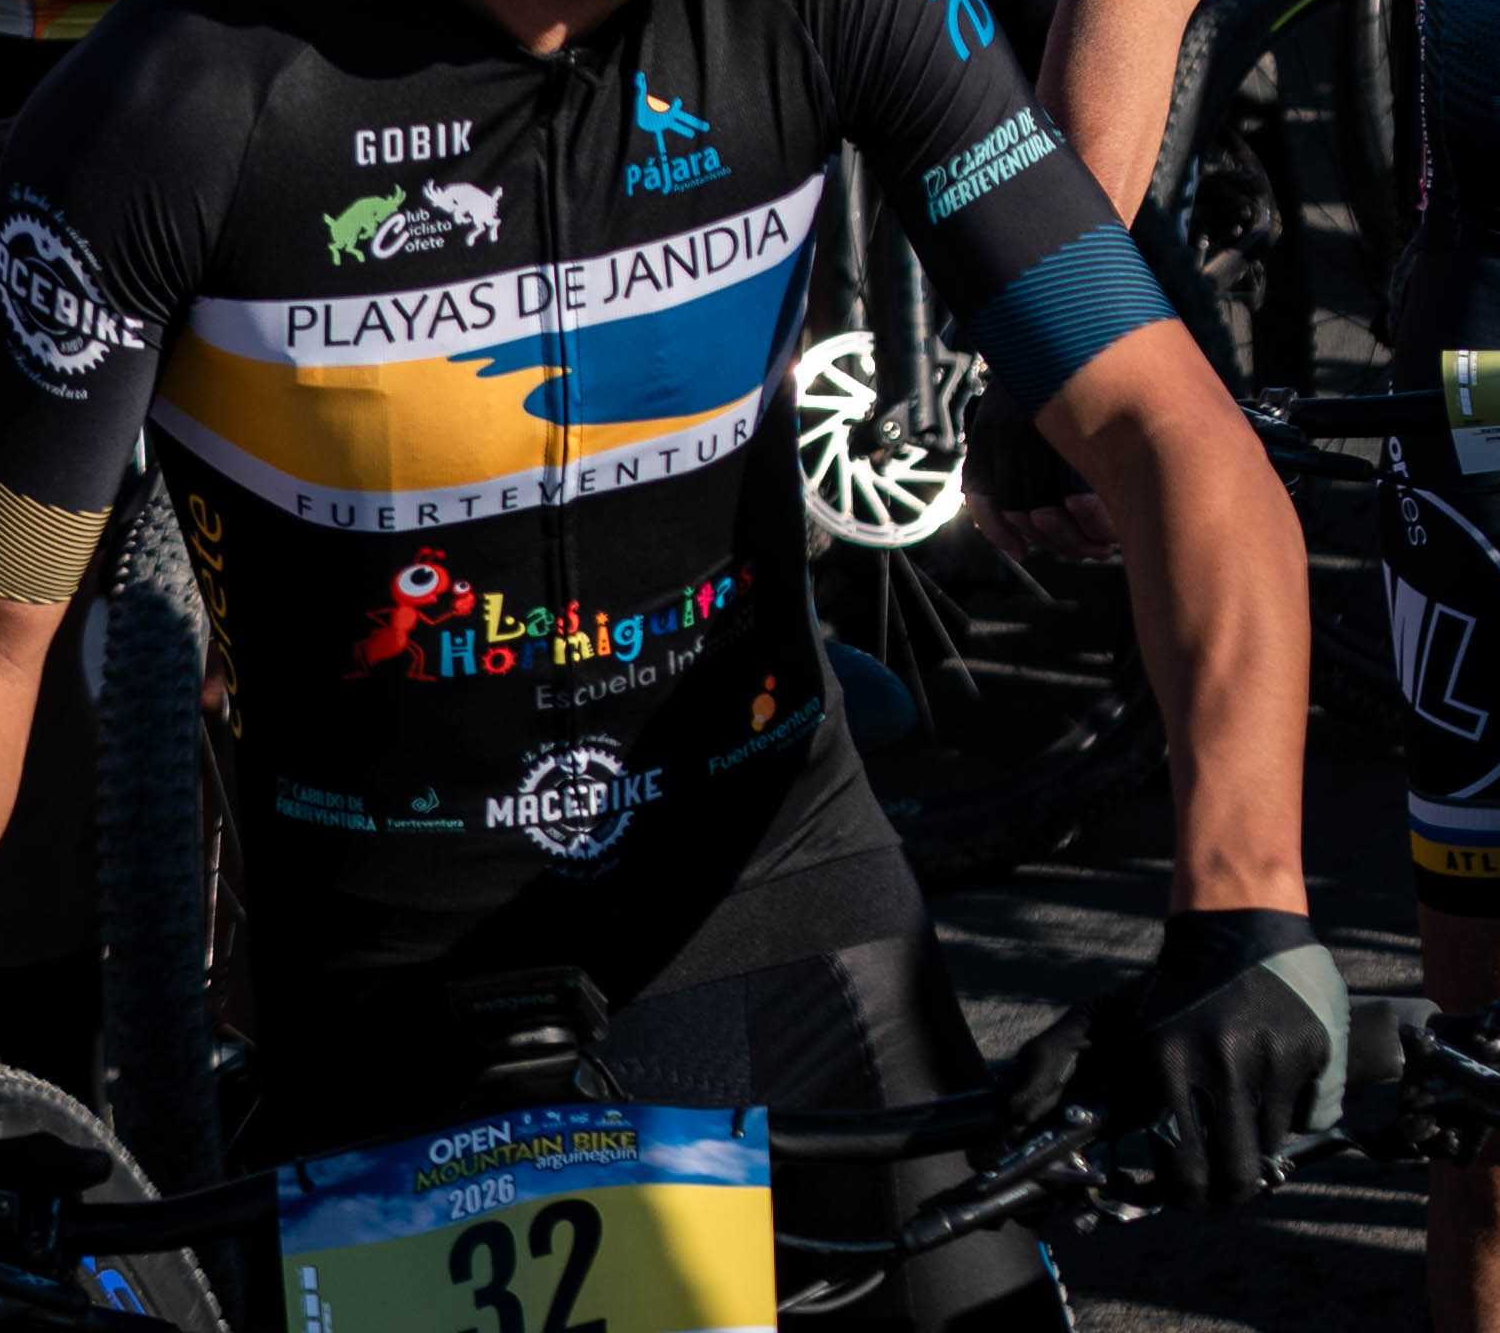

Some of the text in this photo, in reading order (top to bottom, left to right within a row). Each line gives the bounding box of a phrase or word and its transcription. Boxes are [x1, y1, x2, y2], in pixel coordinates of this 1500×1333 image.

[355, 119, 474, 167] GOBIK
[626, 142, 724, 200] Pájara
[949, 106, 1039, 179] CABILDO DE
[927, 128, 1058, 226] FUERTEVENTURA
[287, 208, 791, 348] PLAYAS DE JANDIA
[439, 566, 754, 680] Hormiguitas
[482, 591, 582, 644] Las
[536, 663, 657, 712] Escuela
[484, 767, 666, 831] MACEBIKE
[413, 1130, 638, 1194] MOUNTAIN BIKE
[428, 1120, 513, 1166] OPEN
[448, 1173, 516, 1221] 2026
[448, 1198, 608, 1333] 32
